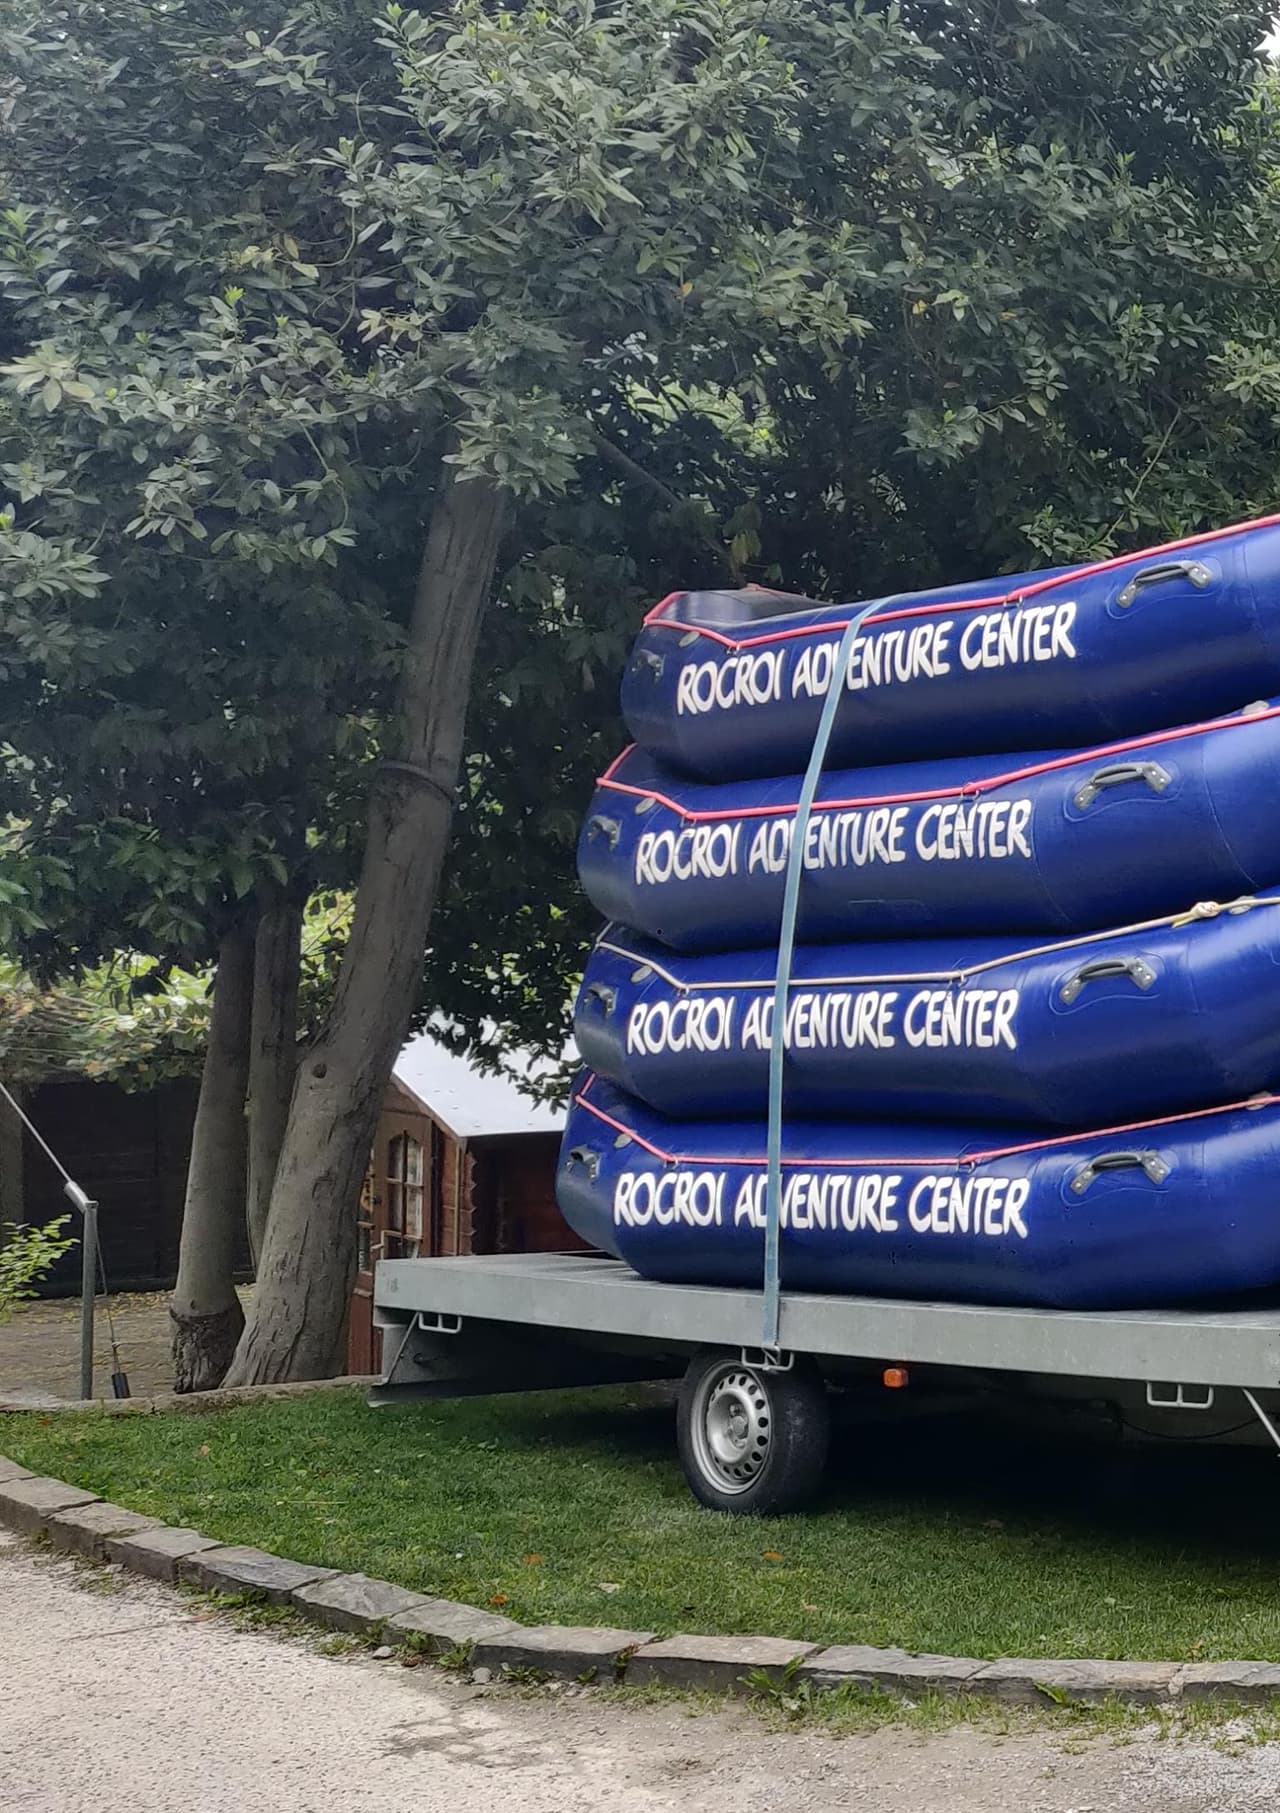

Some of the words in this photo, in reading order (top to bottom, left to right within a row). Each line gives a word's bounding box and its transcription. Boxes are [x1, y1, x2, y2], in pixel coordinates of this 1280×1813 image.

[676, 648, 785, 715] ROCROI
[959, 602, 1077, 671] CENTER
[635, 822, 742, 885] ROCROI
[748, 807, 906, 874] ADENTURE
[915, 799, 1032, 861] CENTER
[626, 997, 735, 1055] ROCROI
[904, 989, 1019, 1050] CENTER
[614, 1171, 726, 1227] ROCROI
[908, 1175, 1030, 1238] CENTER
